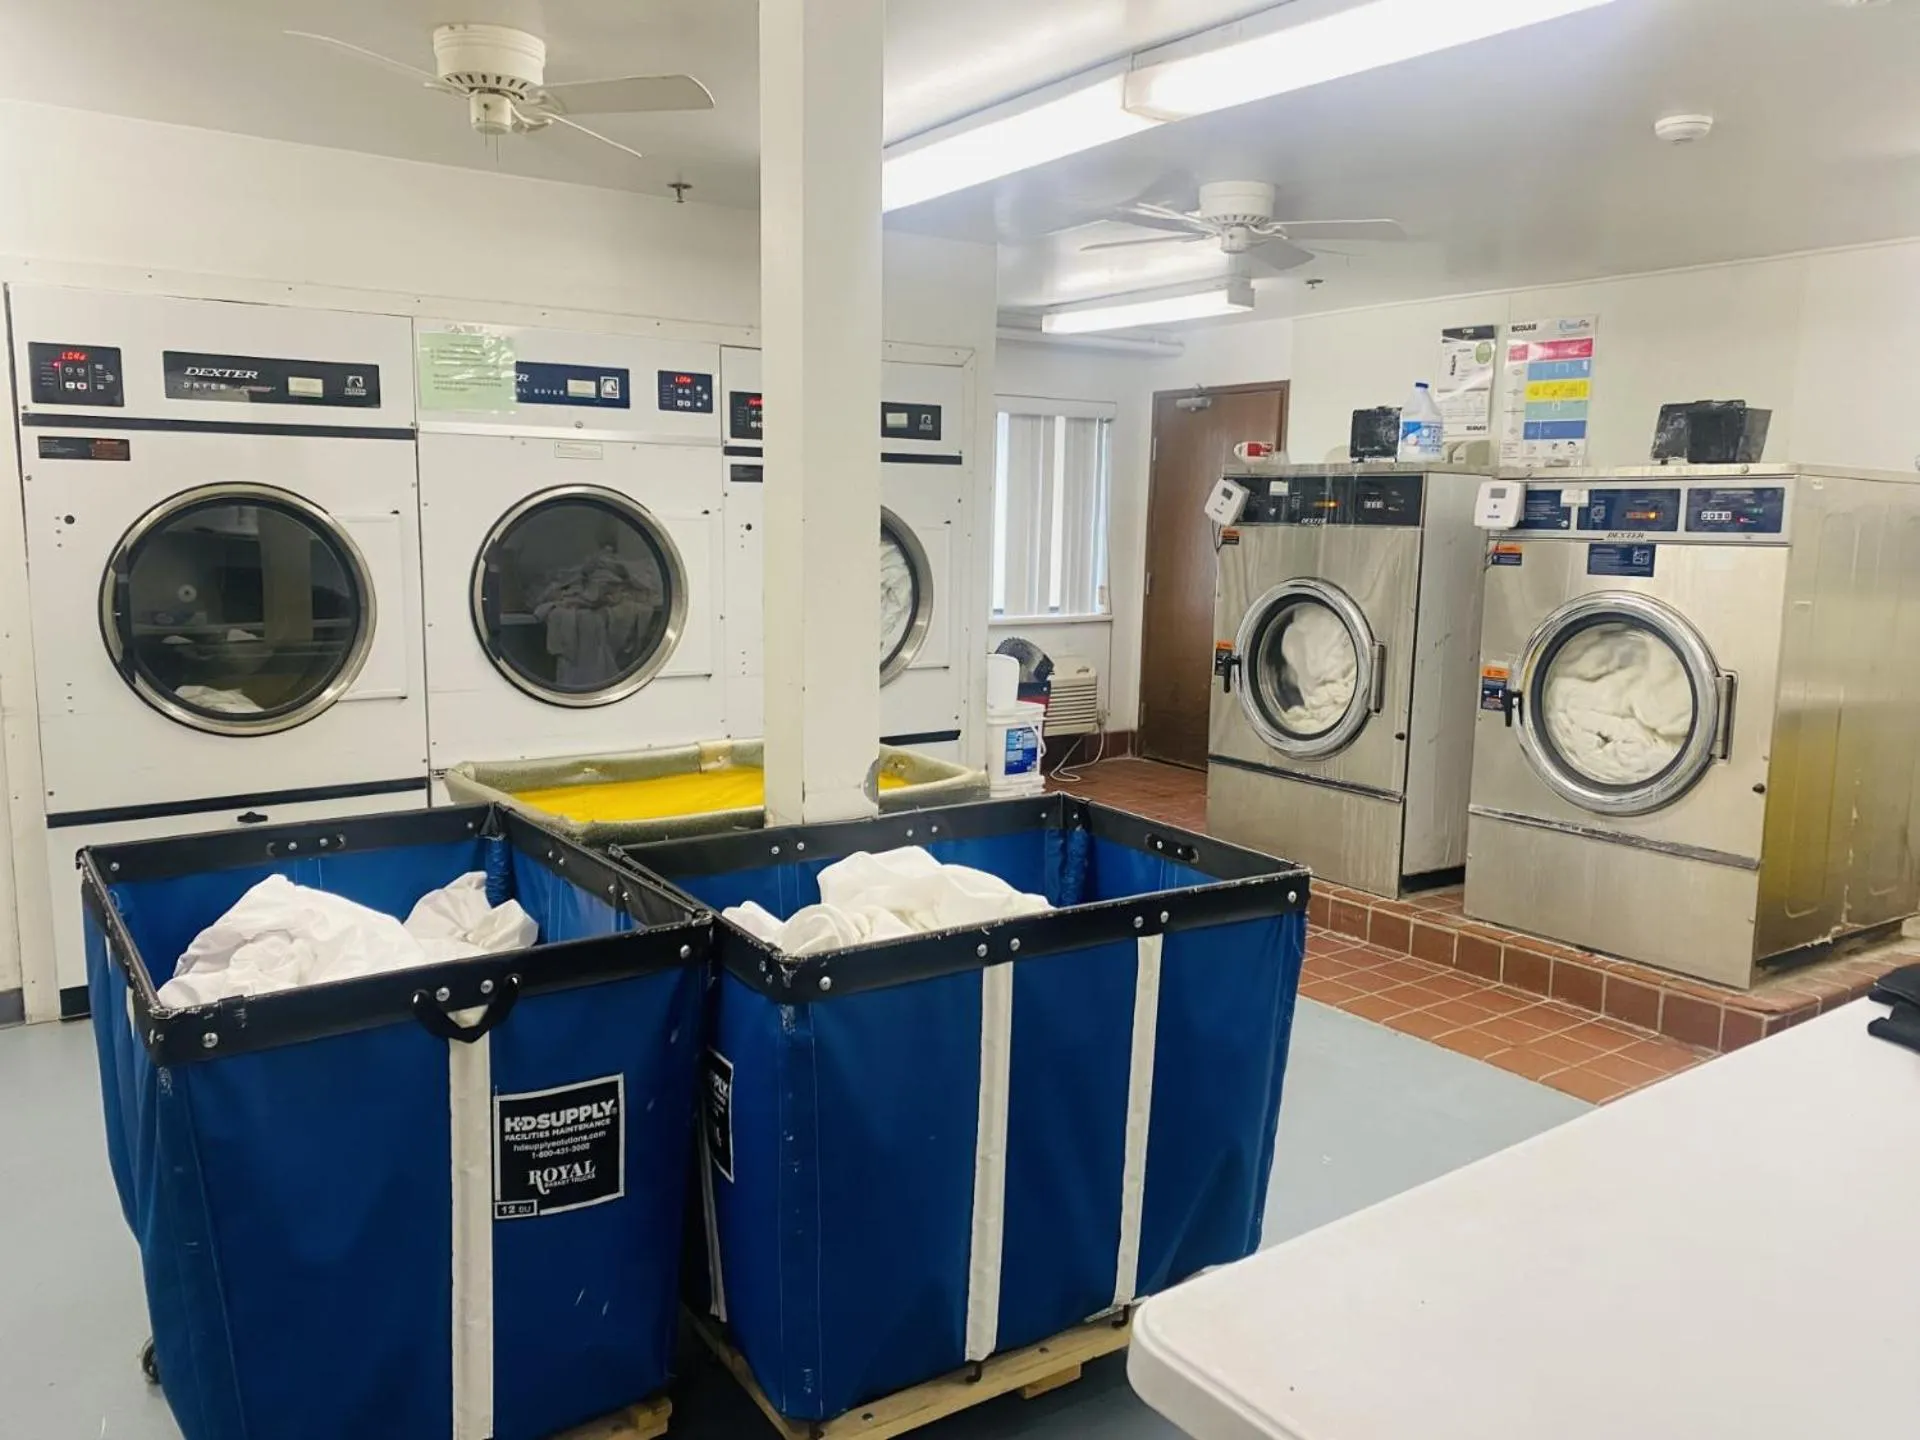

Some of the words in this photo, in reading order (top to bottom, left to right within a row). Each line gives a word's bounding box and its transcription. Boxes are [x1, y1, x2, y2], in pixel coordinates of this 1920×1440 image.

[184, 366, 259, 379] DEXTER
[504, 1130, 549, 1141] FACILITIES
[552, 1118, 611, 1136] MAINTENANCE
[528, 1160, 597, 1196] ROYAL
[501, 1205, 516, 1215] 12
